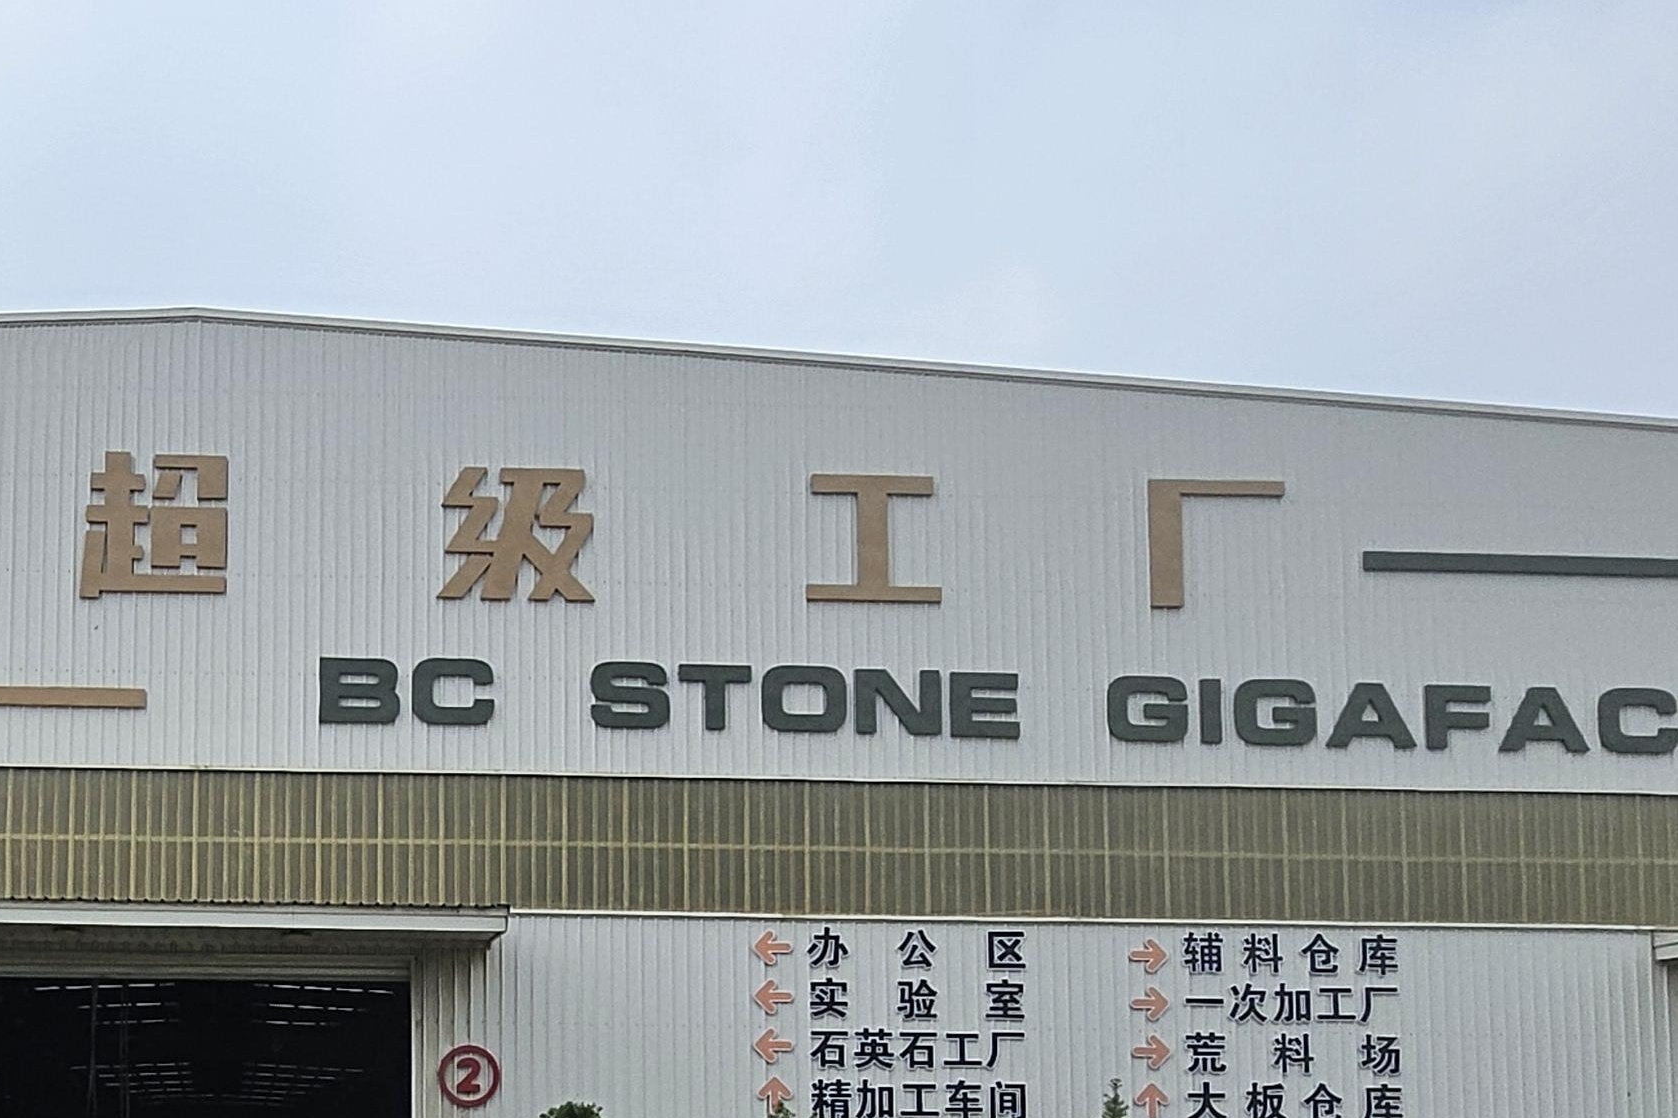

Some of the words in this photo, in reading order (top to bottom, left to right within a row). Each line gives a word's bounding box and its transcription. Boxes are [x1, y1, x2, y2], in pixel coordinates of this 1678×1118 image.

[318, 655, 496, 727] BC
[589, 660, 1022, 741] STONE
[1106, 674, 1678, 755] GIGAFAC
[807, 927, 1026, 969] 办公区
[1184, 932, 1399, 976] 辅料仓库
[810, 978, 1025, 1019] 实验室
[1185, 983, 1398, 1023] 一次加工厂
[810, 1028, 1025, 1068] 石英石工厂
[1185, 1032, 1401, 1075] 荒料场
[456, 1056, 481, 1094] 2
